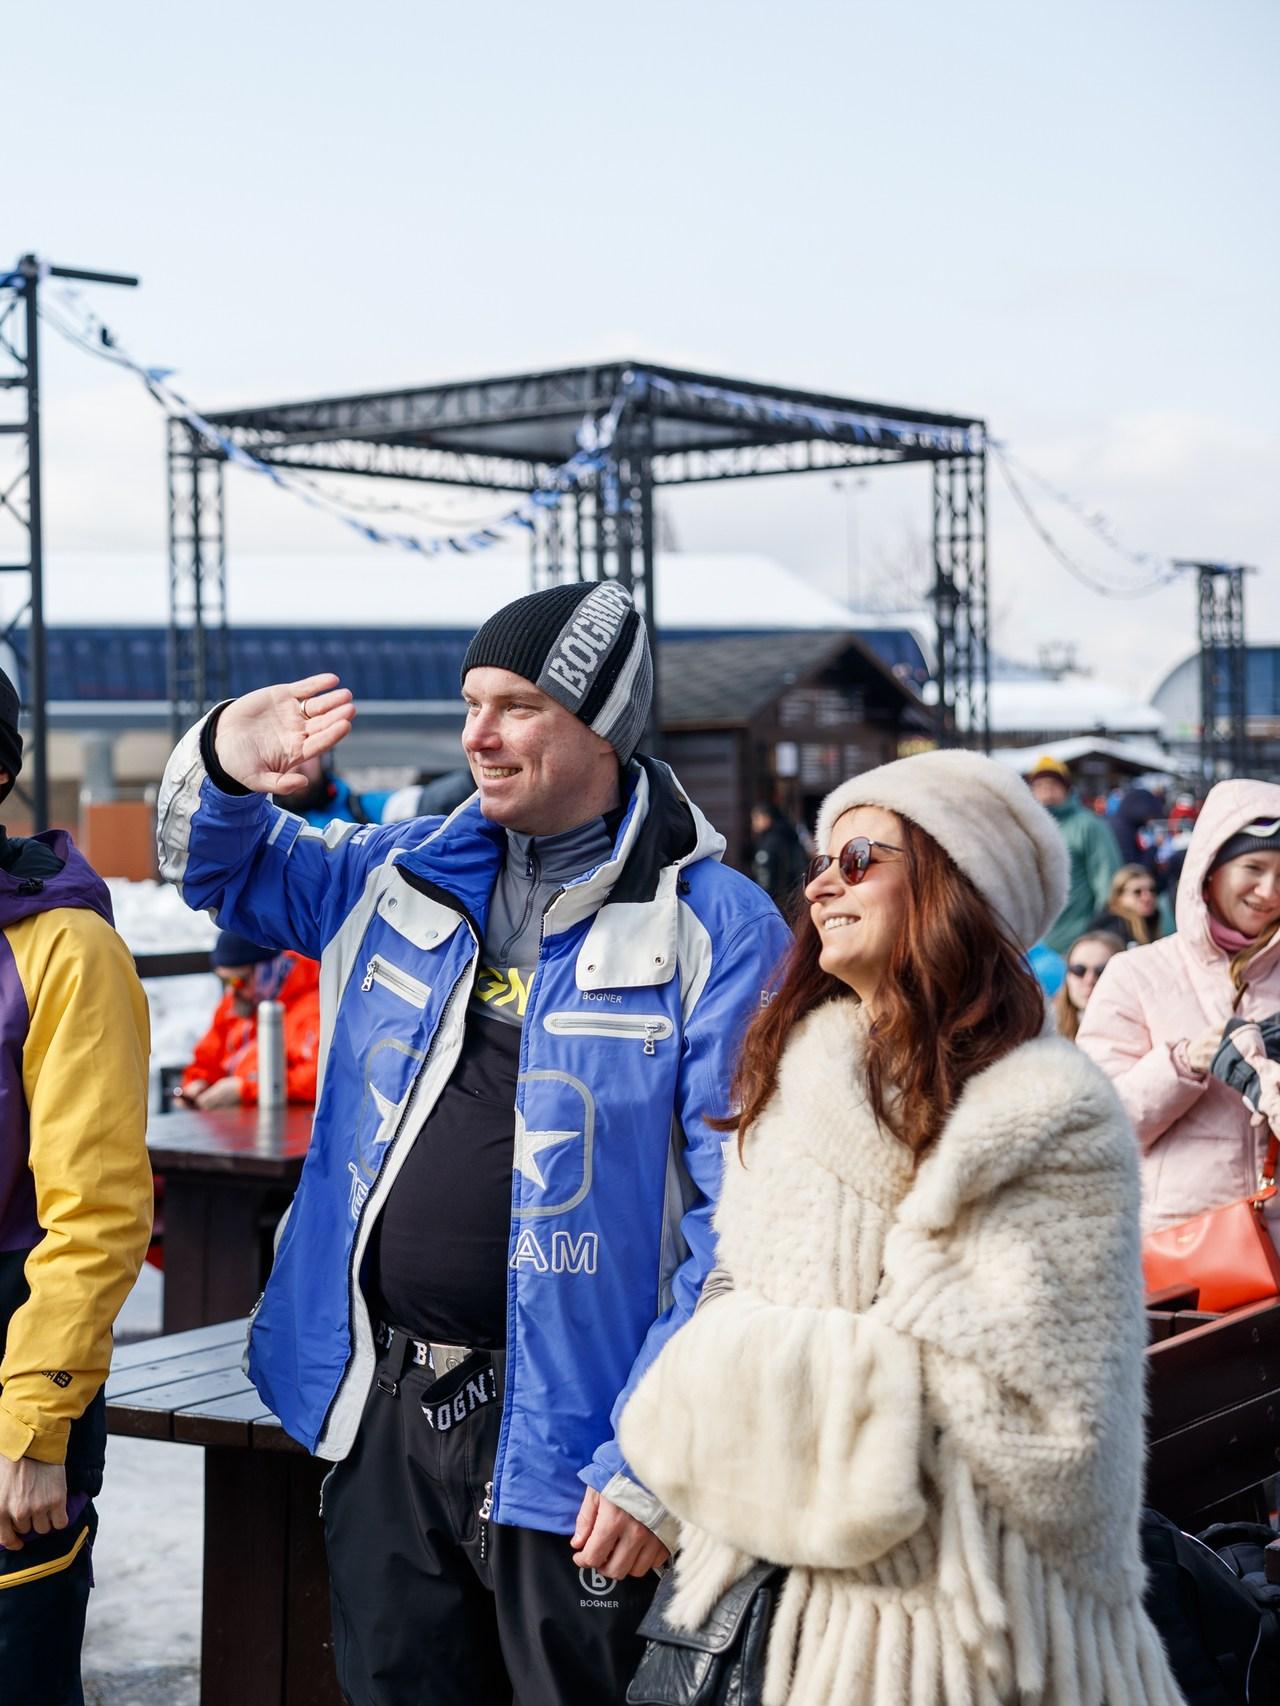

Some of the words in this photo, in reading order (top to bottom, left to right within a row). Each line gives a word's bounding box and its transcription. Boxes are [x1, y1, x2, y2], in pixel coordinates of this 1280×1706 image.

[582, 991, 623, 1004] BOGNER
[509, 1229, 599, 1275] AM
[580, 1599, 620, 1609] BOGNER
